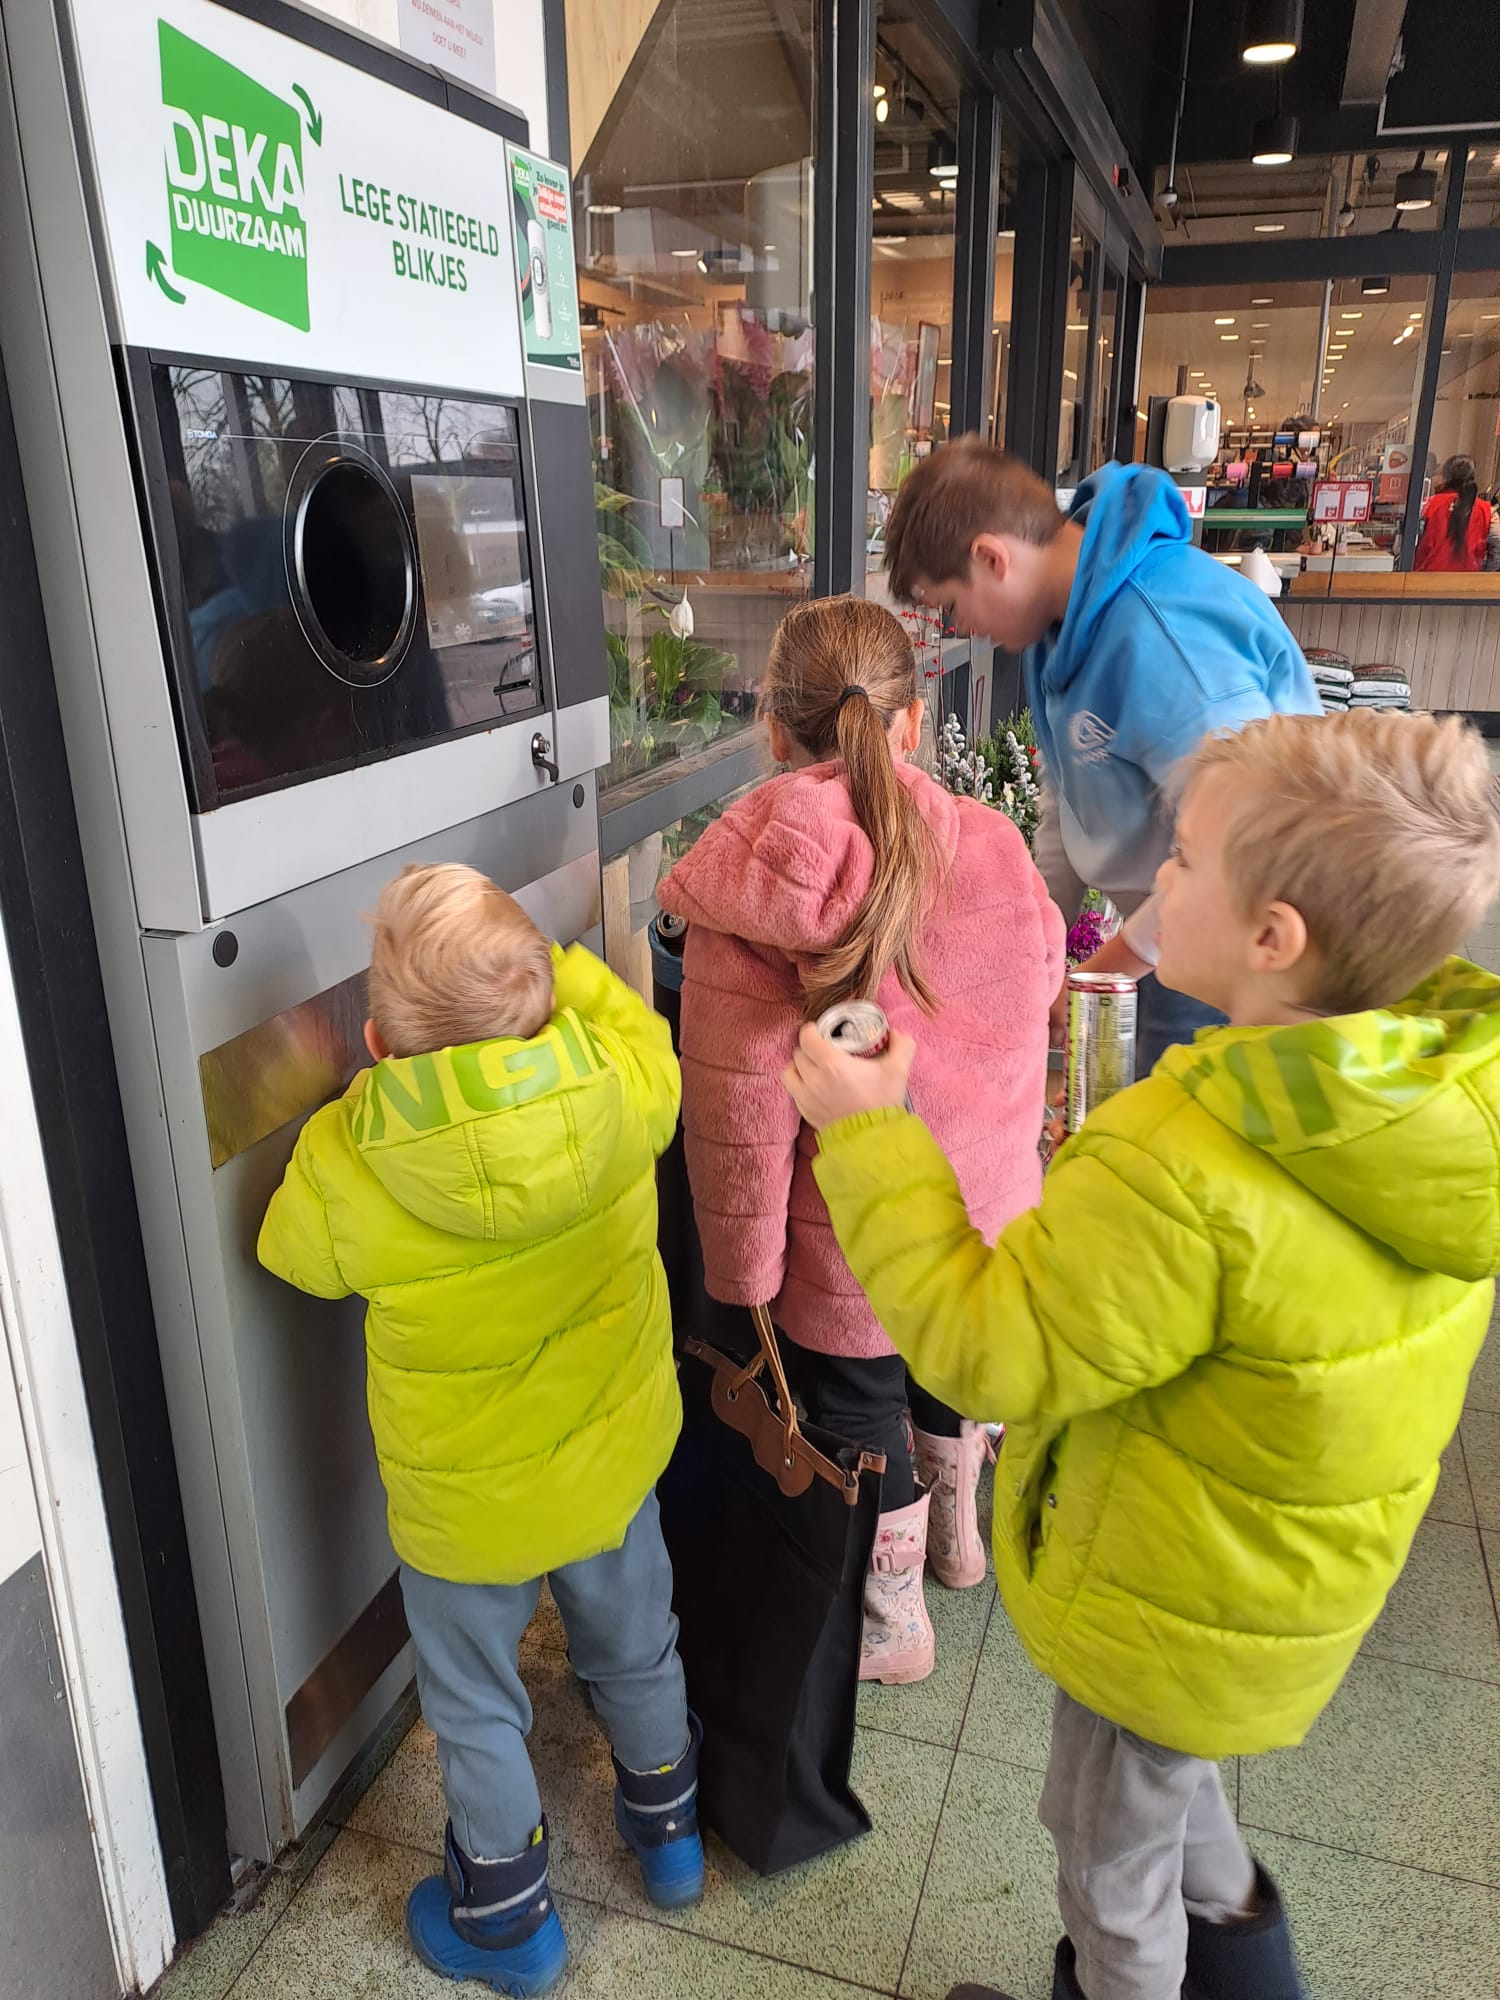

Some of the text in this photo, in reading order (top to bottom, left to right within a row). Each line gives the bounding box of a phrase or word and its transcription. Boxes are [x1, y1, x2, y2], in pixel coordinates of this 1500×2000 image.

[163, 104, 306, 221] DEKA
[172, 193, 305, 258] DUURZAAM
[338, 173, 499, 257] LEGE STATIEGELD
[392, 240, 468, 292] BLIKJES
